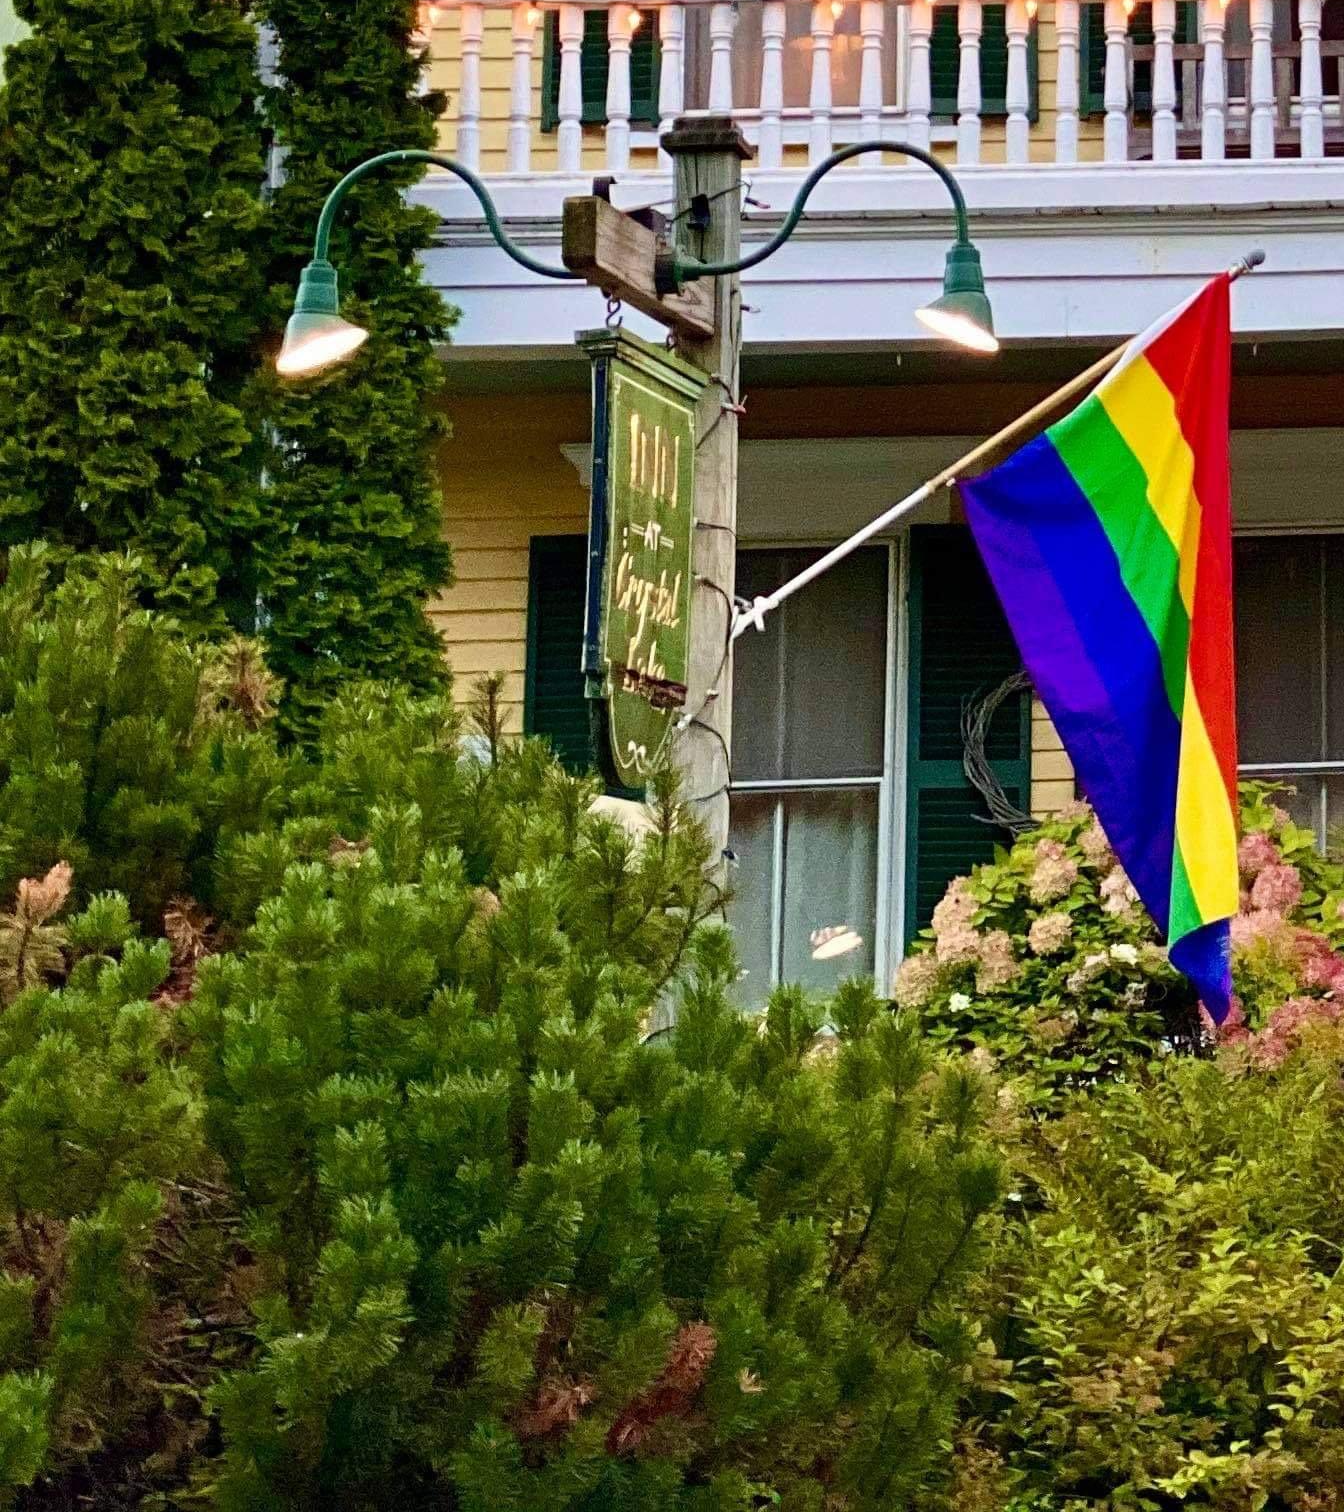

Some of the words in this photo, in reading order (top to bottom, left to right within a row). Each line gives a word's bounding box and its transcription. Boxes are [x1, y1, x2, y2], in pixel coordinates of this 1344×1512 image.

[629, 413, 681, 510] INN
[643, 519, 662, 552] AT
[616, 552, 682, 645] Crystal
